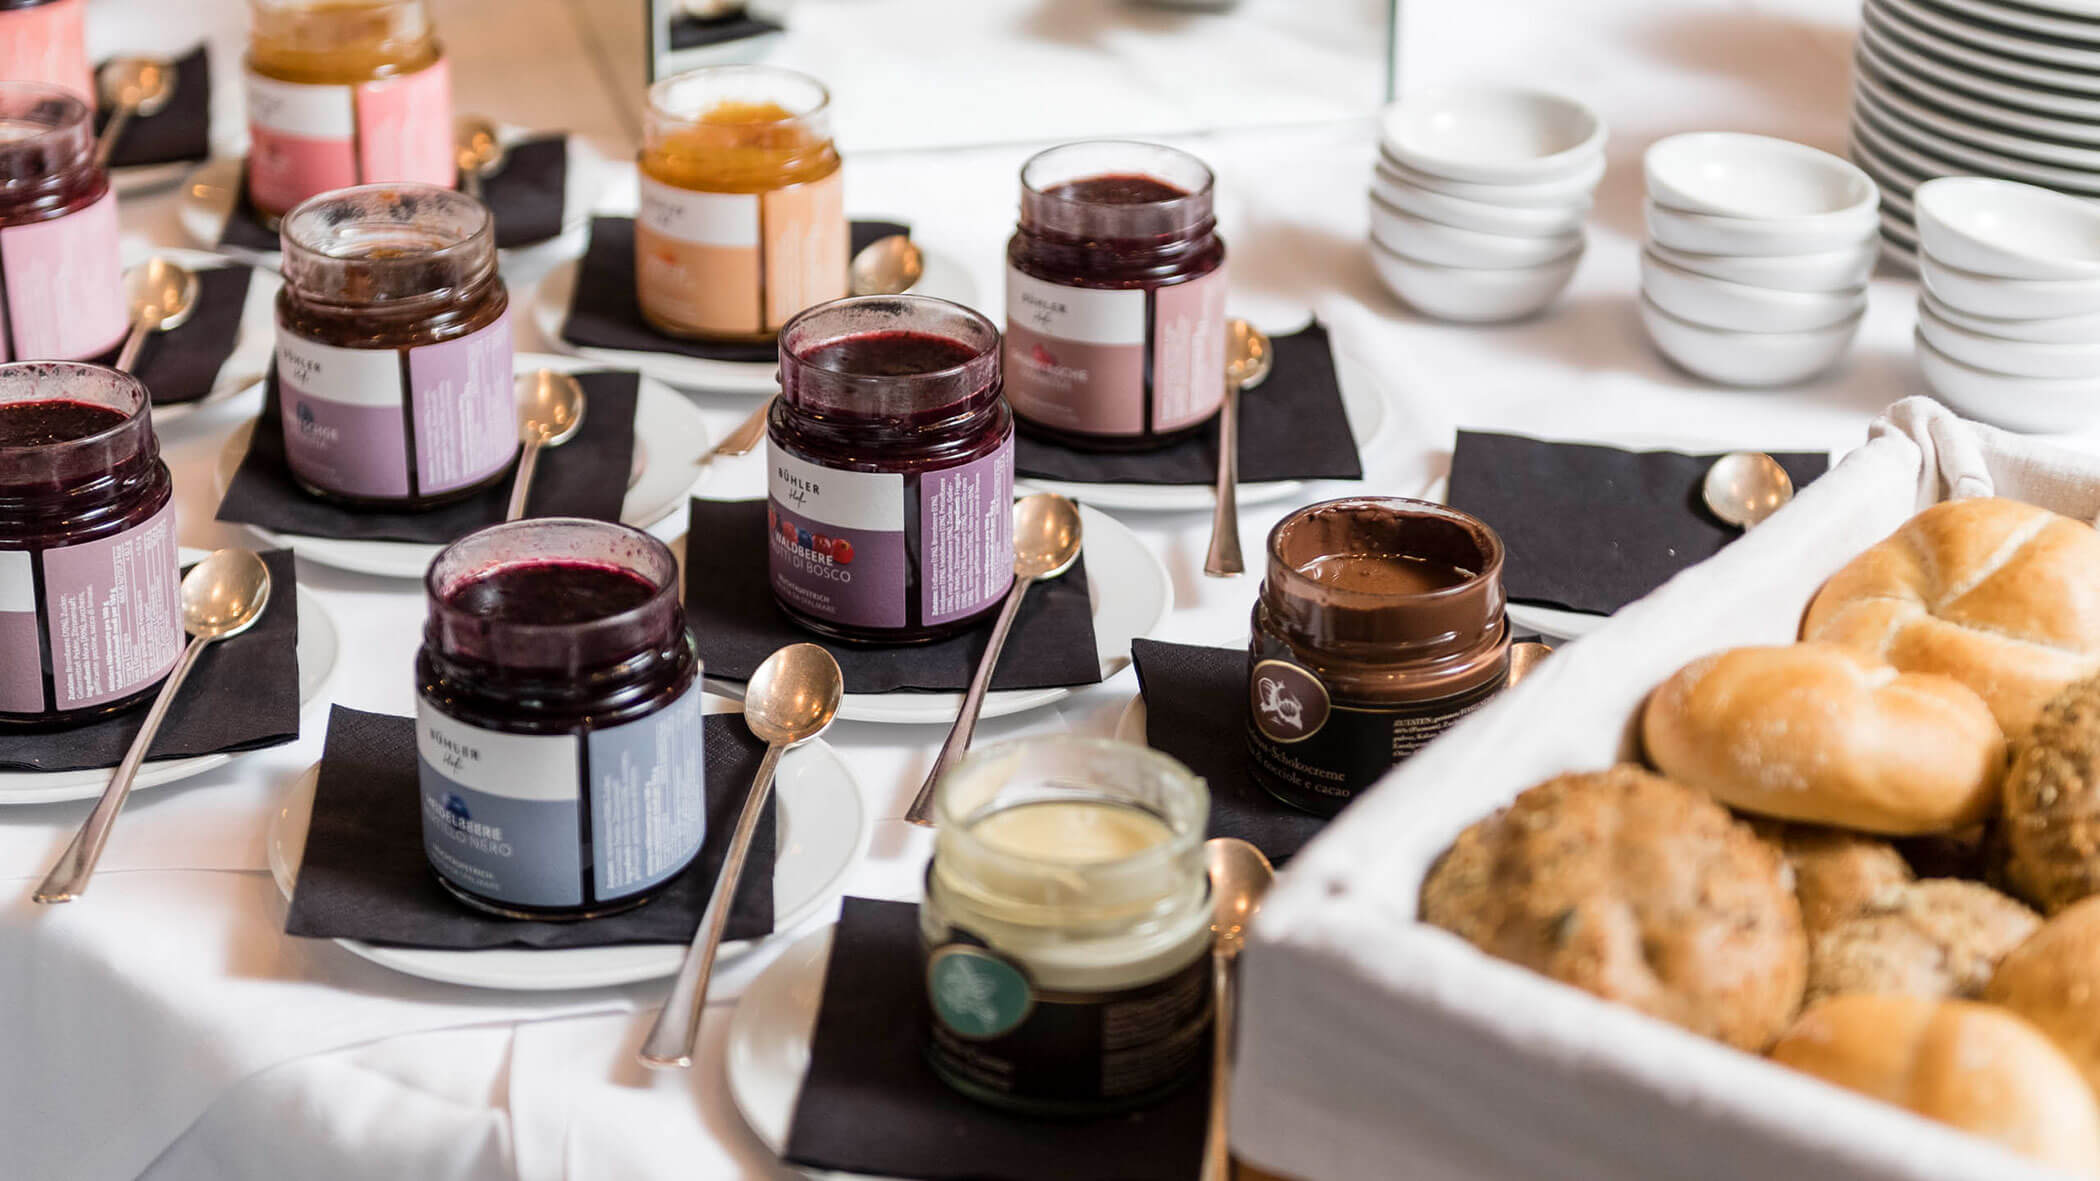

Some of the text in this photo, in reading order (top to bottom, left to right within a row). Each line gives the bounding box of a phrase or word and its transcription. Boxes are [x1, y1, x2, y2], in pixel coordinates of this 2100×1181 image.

[778, 467, 820, 495] BÜHLER
[775, 530, 834, 567] WALDBEERE
[806, 562, 851, 583] BOSCO
[431, 729, 479, 761] BÜHLER
[1314, 784, 1350, 797] cacao
[470, 835, 512, 857] NERO
